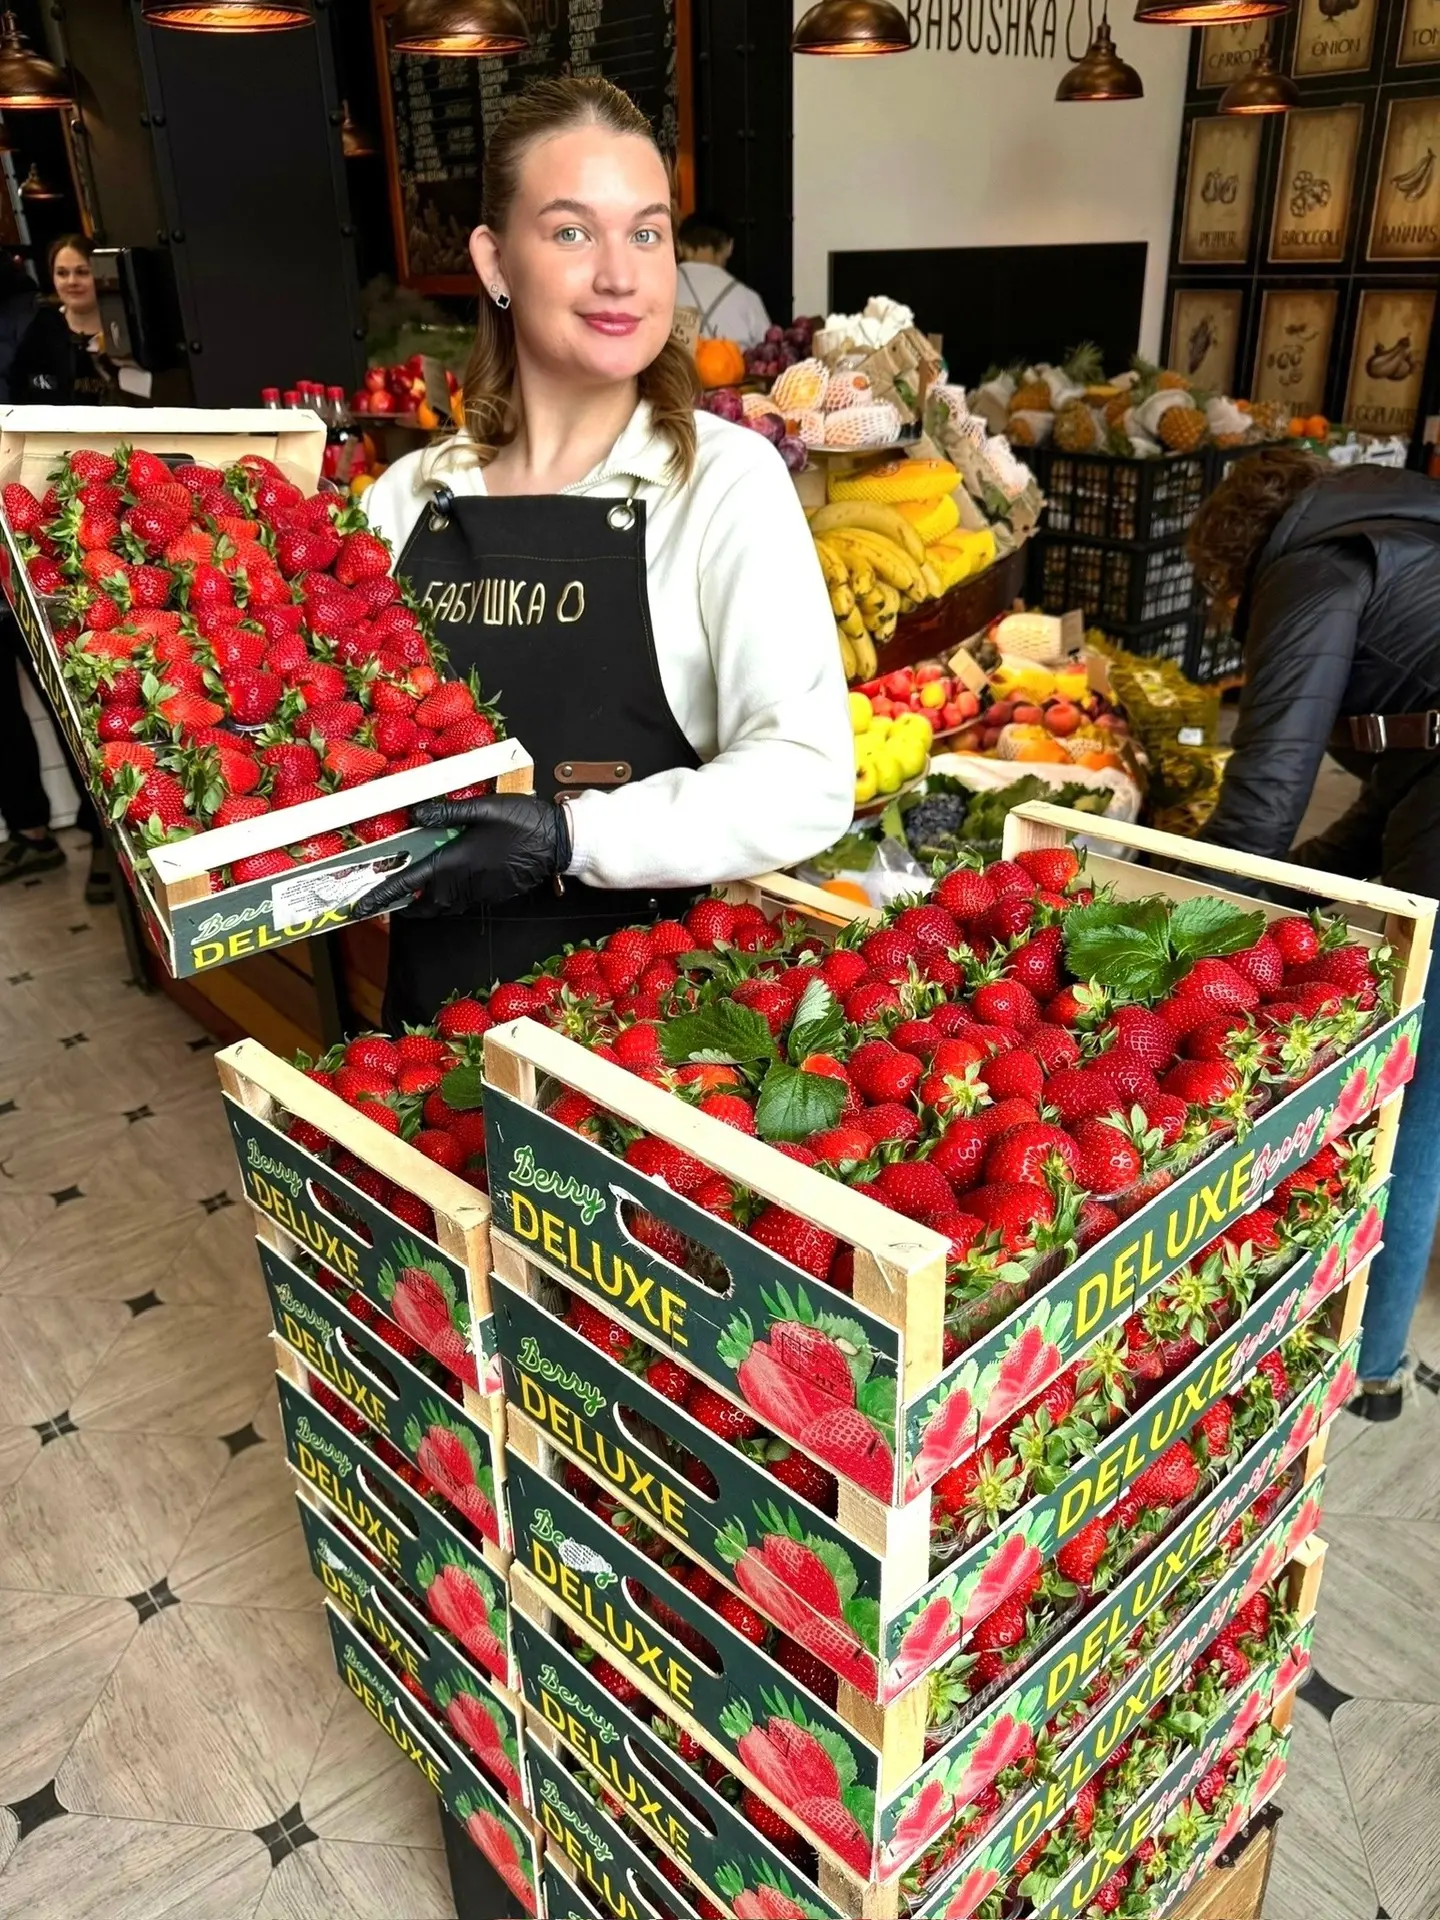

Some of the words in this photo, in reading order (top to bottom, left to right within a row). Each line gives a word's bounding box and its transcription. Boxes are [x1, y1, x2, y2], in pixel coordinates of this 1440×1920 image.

[907, 0, 1057, 59] BABUSHKA
[1311, 38, 1361, 57] ONION
[1380, 224, 1438, 244] BANANAS
[421, 578, 546, 626] БАБУШКА
[190, 900, 274, 945] Berr
[247, 1137, 303, 1198] Berry
[508, 1144, 606, 1226] Berry
[1075, 1149, 1255, 1341] DELUXE
[1241, 1106, 1325, 1207] Berry
[253, 1171, 364, 1287] DELUXE
[511, 1189, 688, 1347] DELUXE
[278, 1283, 335, 1343] Berry
[284, 1312, 391, 1434] DELUXE
[517, 1336, 607, 1417] Berry
[294, 1415, 353, 1479] Berry
[519, 1371, 689, 1538] DELUXE
[1057, 1342, 1238, 1539] DELUXE
[298, 1442, 401, 1568] DELUXE
[321, 1560, 423, 1686] DELUXE
[532, 1538, 694, 1710] DELUXE
[1046, 1507, 1217, 1711] DELUXE
[342, 1643, 395, 1707] Berry
[345, 1663, 444, 1796] DELUXE
[537, 1663, 620, 1745] Berry
[541, 1688, 693, 1864] DELUXE
[1013, 1650, 1175, 1855] DELUXE
[540, 1778, 614, 1862] Berry
[541, 1801, 638, 1920] DELU
